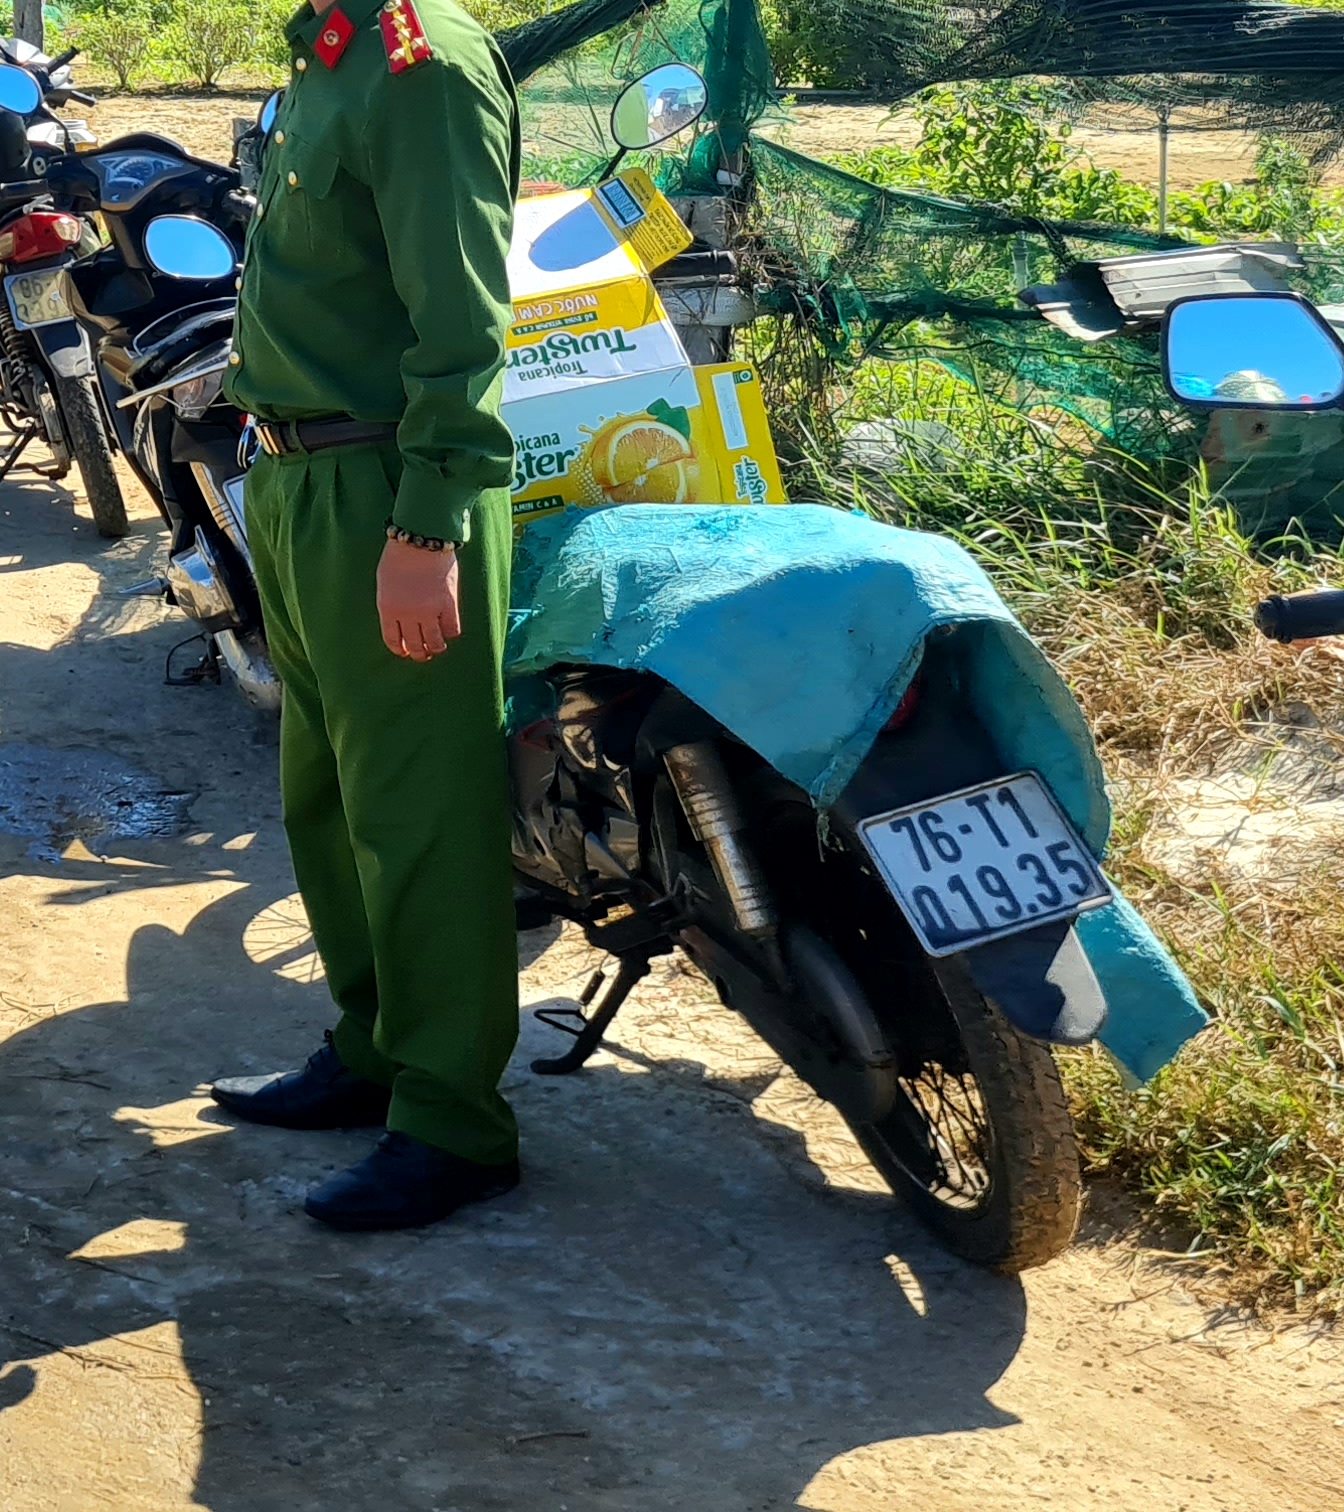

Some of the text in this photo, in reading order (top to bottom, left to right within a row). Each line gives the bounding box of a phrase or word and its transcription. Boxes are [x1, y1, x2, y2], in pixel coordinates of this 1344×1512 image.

[518, 302, 553, 320] CAM
[518, 360, 588, 381] Tropicana
[890, 787, 1040, 873] 76-T1
[912, 840, 1090, 940] 019.35
